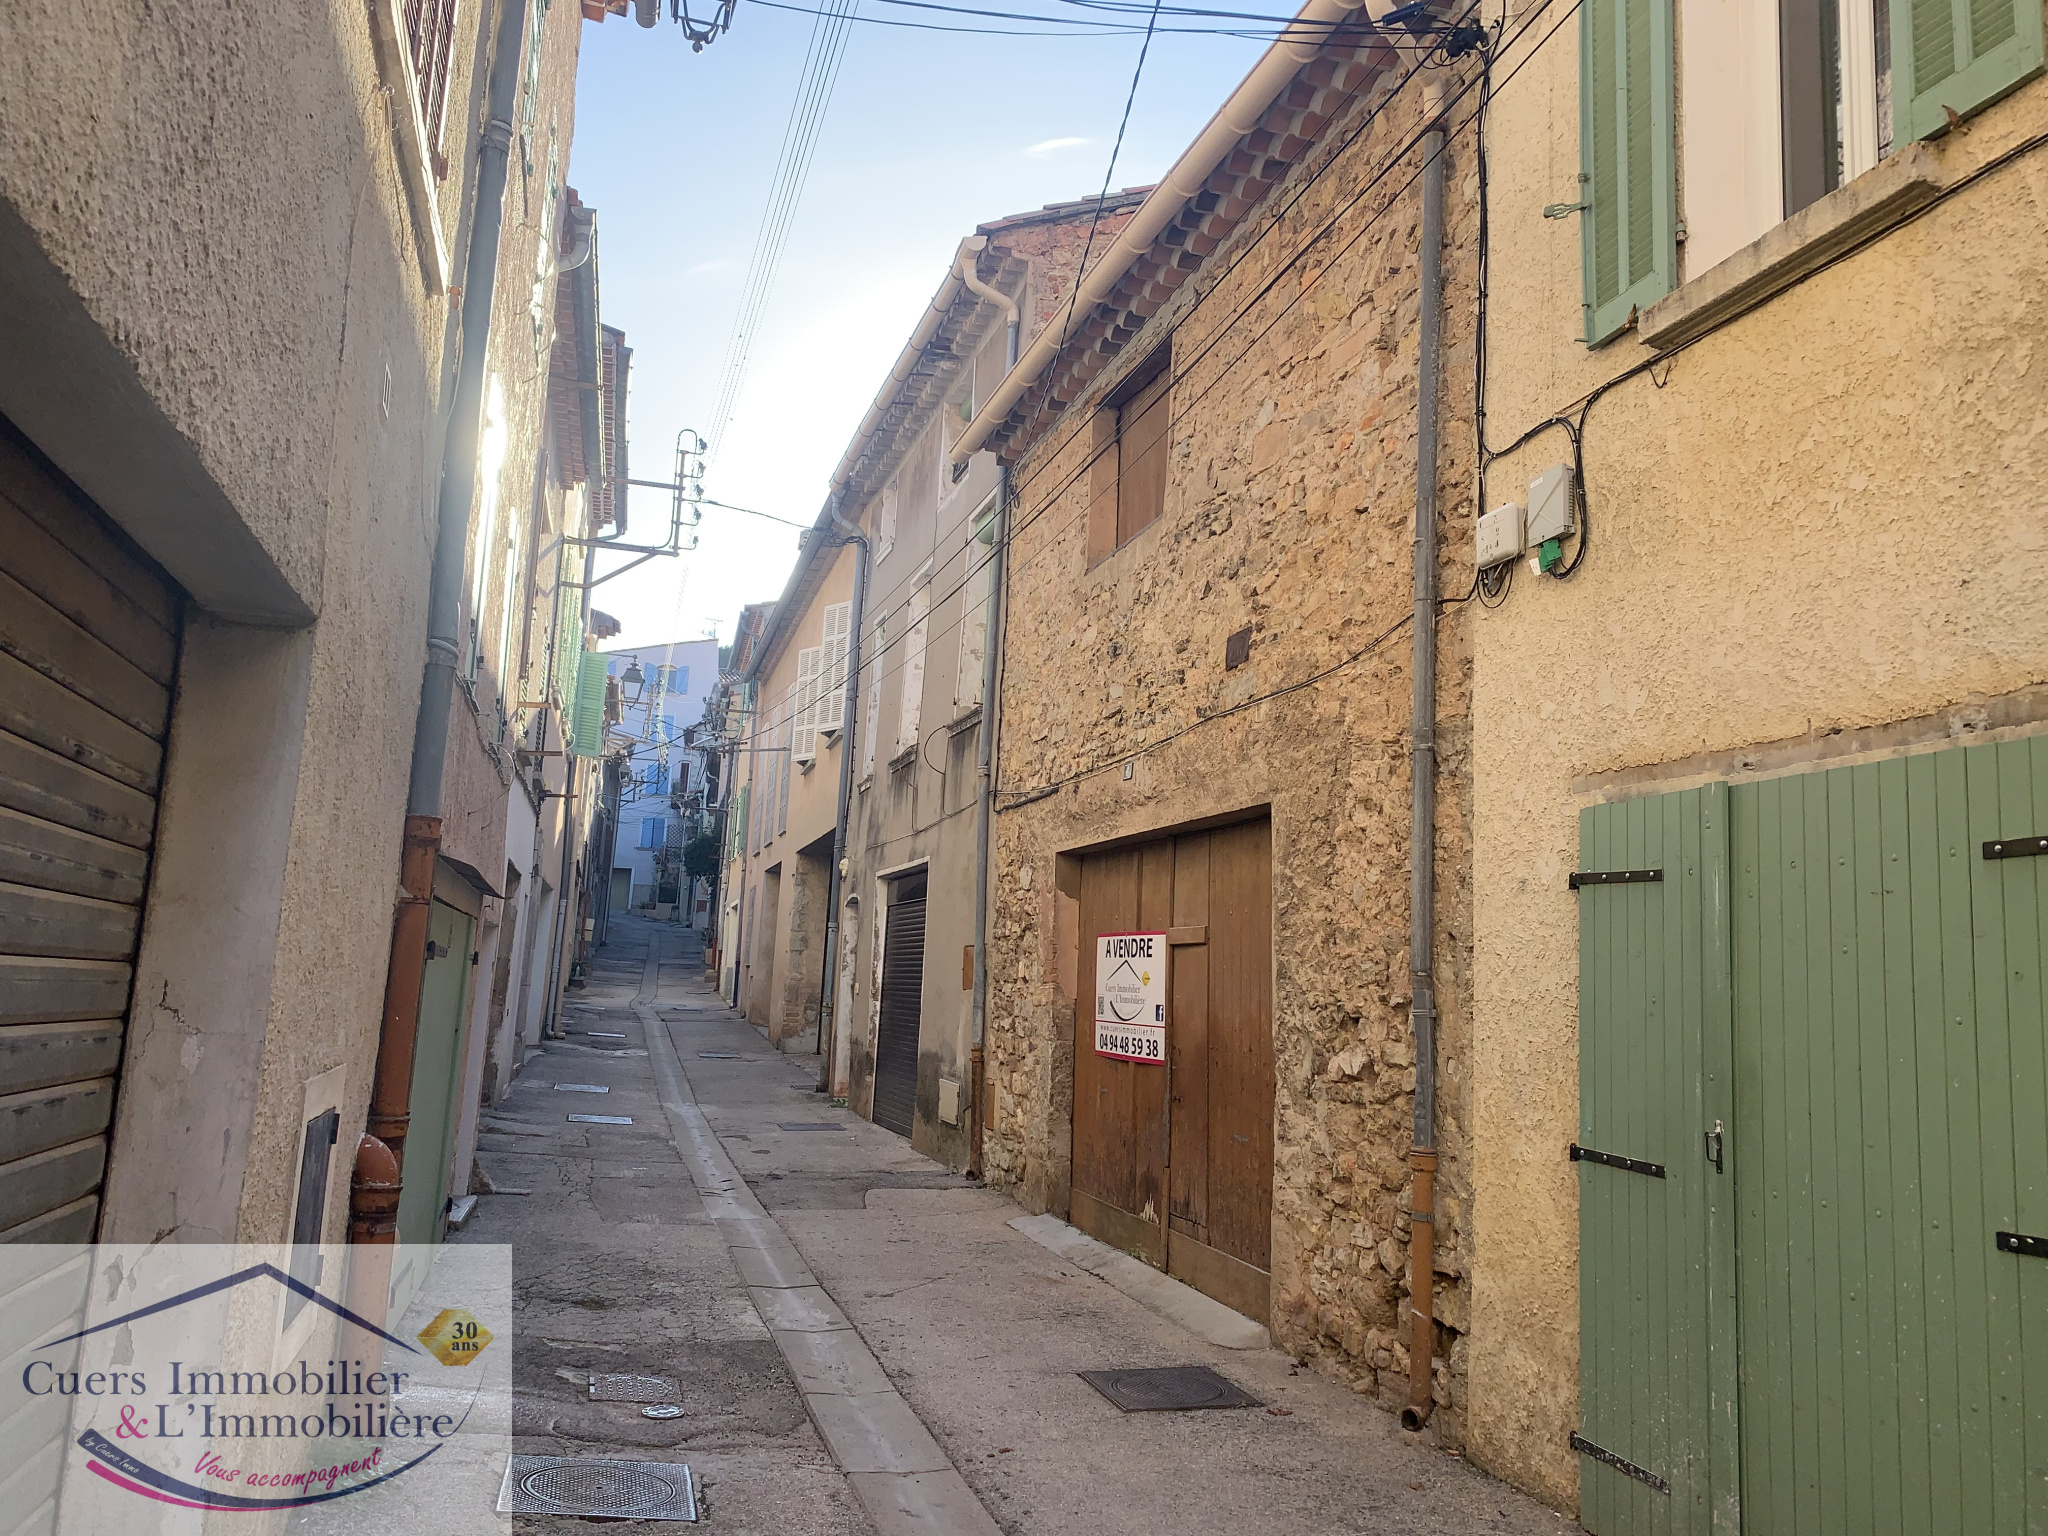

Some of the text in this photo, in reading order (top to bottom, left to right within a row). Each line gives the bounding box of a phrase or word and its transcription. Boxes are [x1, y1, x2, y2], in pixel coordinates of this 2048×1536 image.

[1105, 937, 1154, 959] A VENDRE
[1099, 1033, 1159, 1058] 04 94 48 59 38
